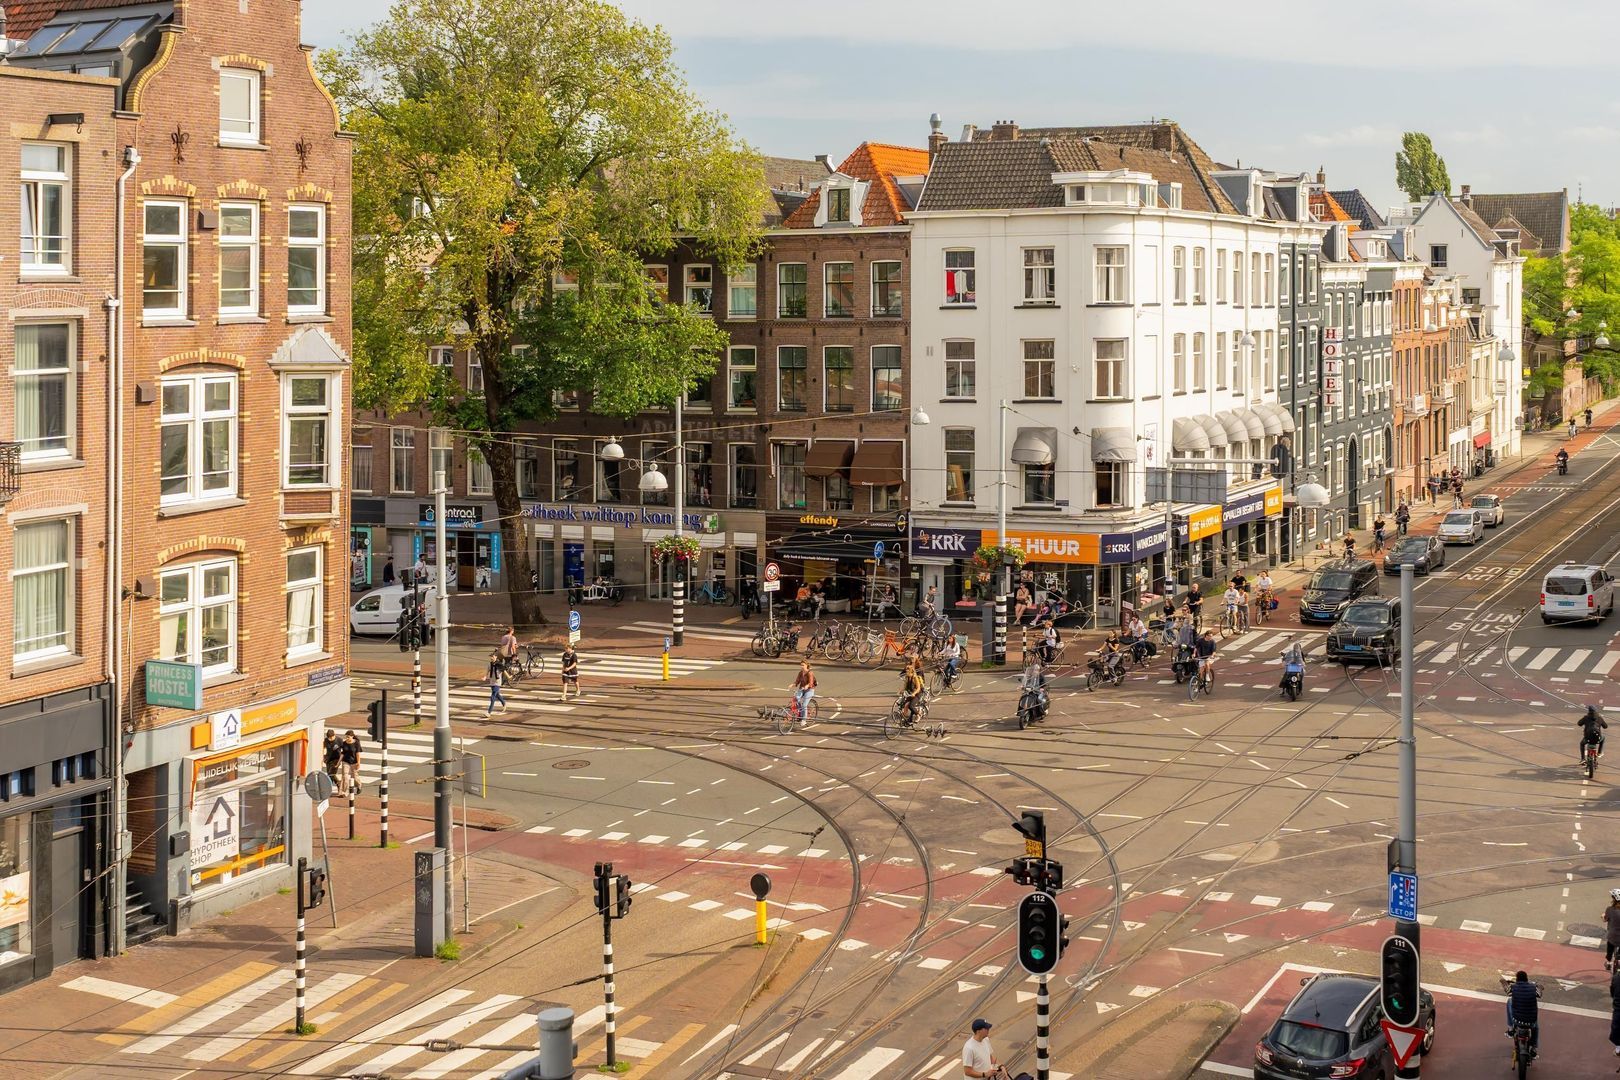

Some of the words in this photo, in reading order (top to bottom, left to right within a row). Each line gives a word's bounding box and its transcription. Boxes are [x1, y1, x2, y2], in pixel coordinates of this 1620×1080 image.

[1325, 328, 1336, 405] HOTEL
[445, 507, 476, 519] entraal
[525, 503, 578, 521] theek
[583, 506, 637, 528] wittop
[641, 507, 703, 531] konng
[800, 515, 838, 528] effendy
[932, 534, 966, 551] KRK
[1026, 538, 1080, 556] HUUR
[1136, 530, 1167, 551] WINKELRUIMT
[1112, 543, 1131, 553] KRK
[768, 568, 777, 577] 30
[1445, 622, 1509, 633] BUS
[149, 665, 192, 680] PRINCESS
[149, 679, 192, 698] HOSTEL
[191, 835, 238, 856] HYPOTHEEK
[190, 852, 212, 866] SHOP
[1032, 894, 1046, 902] 112
[1390, 907, 1403, 915] LET
[1394, 939, 1406, 948] 111
